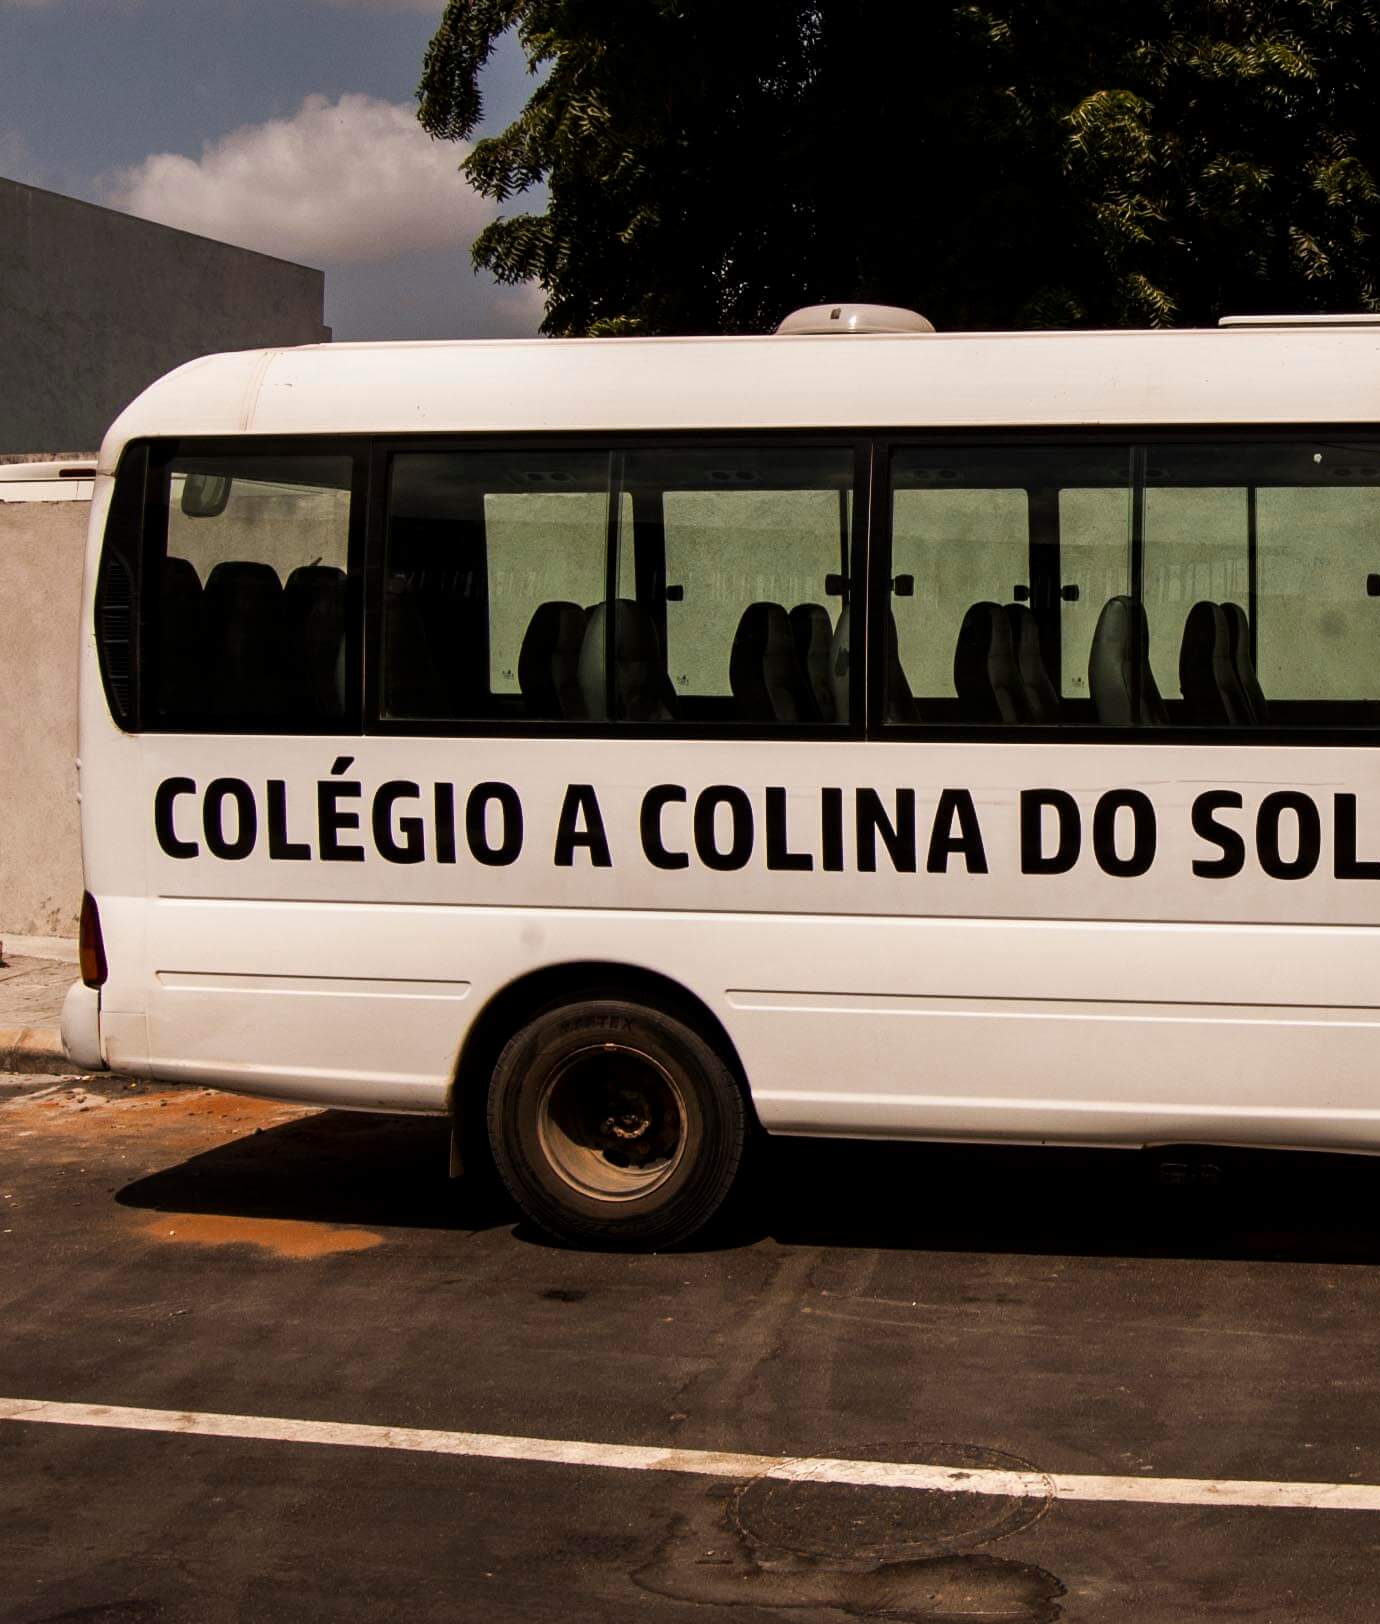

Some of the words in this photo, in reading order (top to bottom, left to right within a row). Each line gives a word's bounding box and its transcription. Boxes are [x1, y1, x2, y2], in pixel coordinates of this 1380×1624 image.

[154, 756, 524, 867] COLÉGIO
[554, 783, 613, 868] A
[639, 783, 989, 875] COLINA
[1020, 788, 1157, 878] DO
